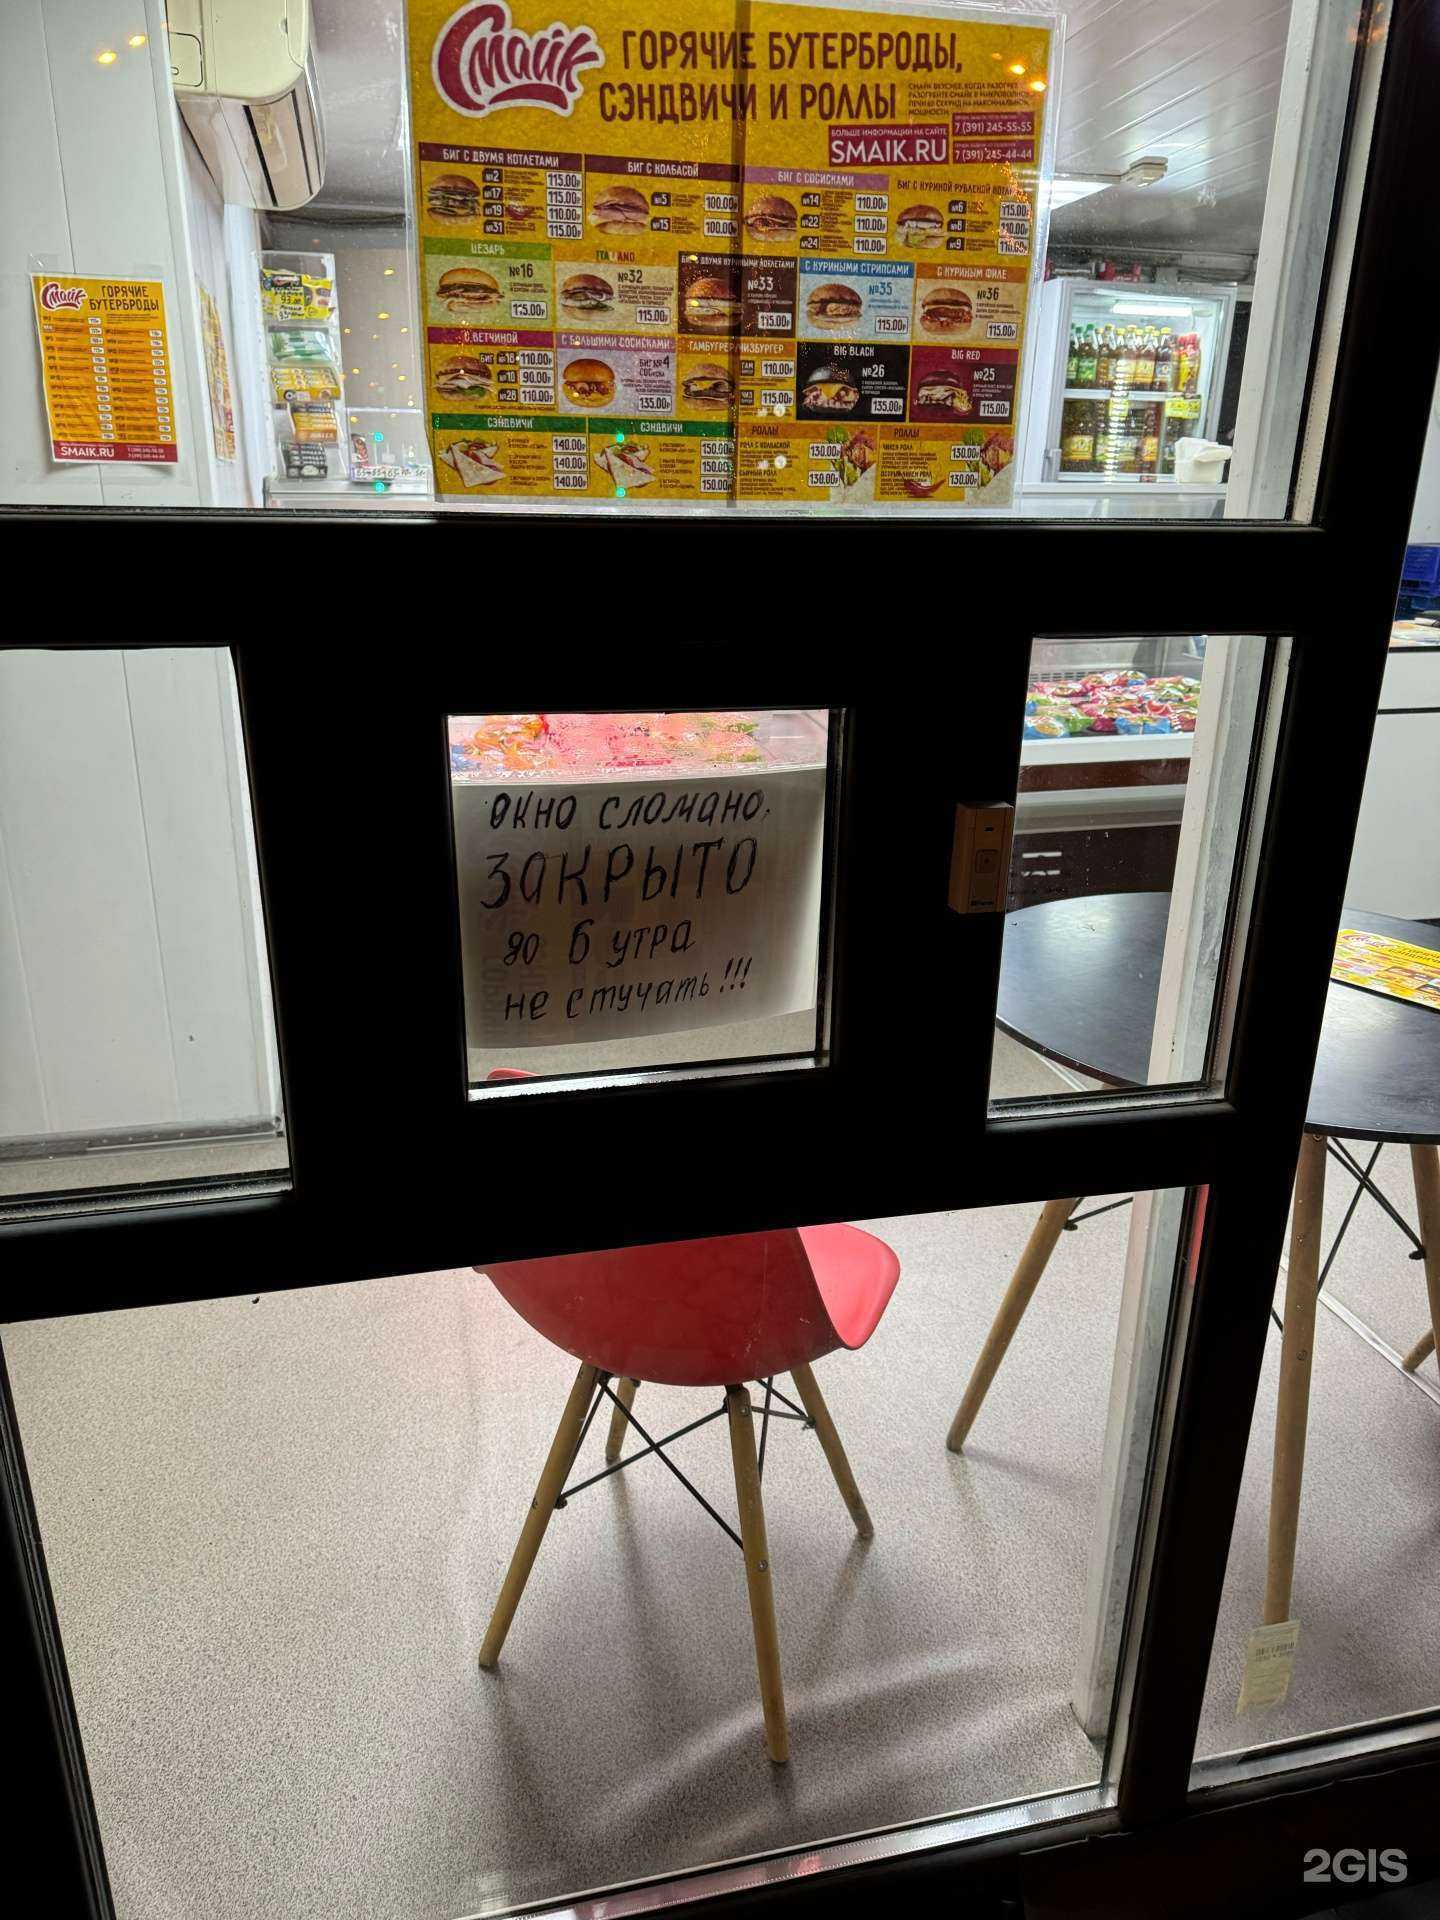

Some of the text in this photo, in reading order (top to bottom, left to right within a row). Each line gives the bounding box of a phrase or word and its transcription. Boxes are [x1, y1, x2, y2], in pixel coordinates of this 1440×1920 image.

[437, 3, 599, 111] Смайк
[622, 30, 963, 74] ГОРЯЧИЕ БУТЕРБРОДЫ,
[599, 82, 897, 122] СЭНДВИЧИ И РОЛЛЫ
[955, 121, 1032, 134] 7 (391) 245-55-55
[443, 148, 559, 167] БИГ С ДВУМЯ КОТЛЕТАМИ
[831, 139, 946, 163] SMAIK.RU
[955, 148, 1031, 161] 7 (391) 245-44-44
[628, 162, 699, 176] БИГ С КОЛБАСОЙ
[778, 171, 854, 187] БИГ С СОСИСКАМИ
[897, 180, 911, 189] БИГ
[913, 181, 918, 190] С
[920, 180, 952, 192] КУРИНОЙ
[509, 264, 534, 278] №16
[805, 261, 909, 275] С КУРИНЫМИ СТРИПСАМИ
[944, 267, 982, 278] КУРИНЫМ
[985, 268, 1007, 280] ФИЛЕ
[618, 270, 643, 283] №32
[748, 276, 774, 290] №33
[102, 285, 149, 299] ГОРЯЧИЕ
[869, 283, 892, 295] №35
[977, 288, 999, 300] №36
[89, 297, 159, 311] БУТЕРБРОДЫ
[833, 346, 847, 356] BIG
[951, 350, 981, 360] BIG RED
[862, 364, 885, 378] №26
[974, 368, 995, 381] №25
[488, 417, 533, 429] СЭНДВИЧИ
[640, 422, 683, 433] СЭНДВИЧИ
[61, 446, 115, 458] SMAIK.RU
[489, 791, 577, 830] ОКНО
